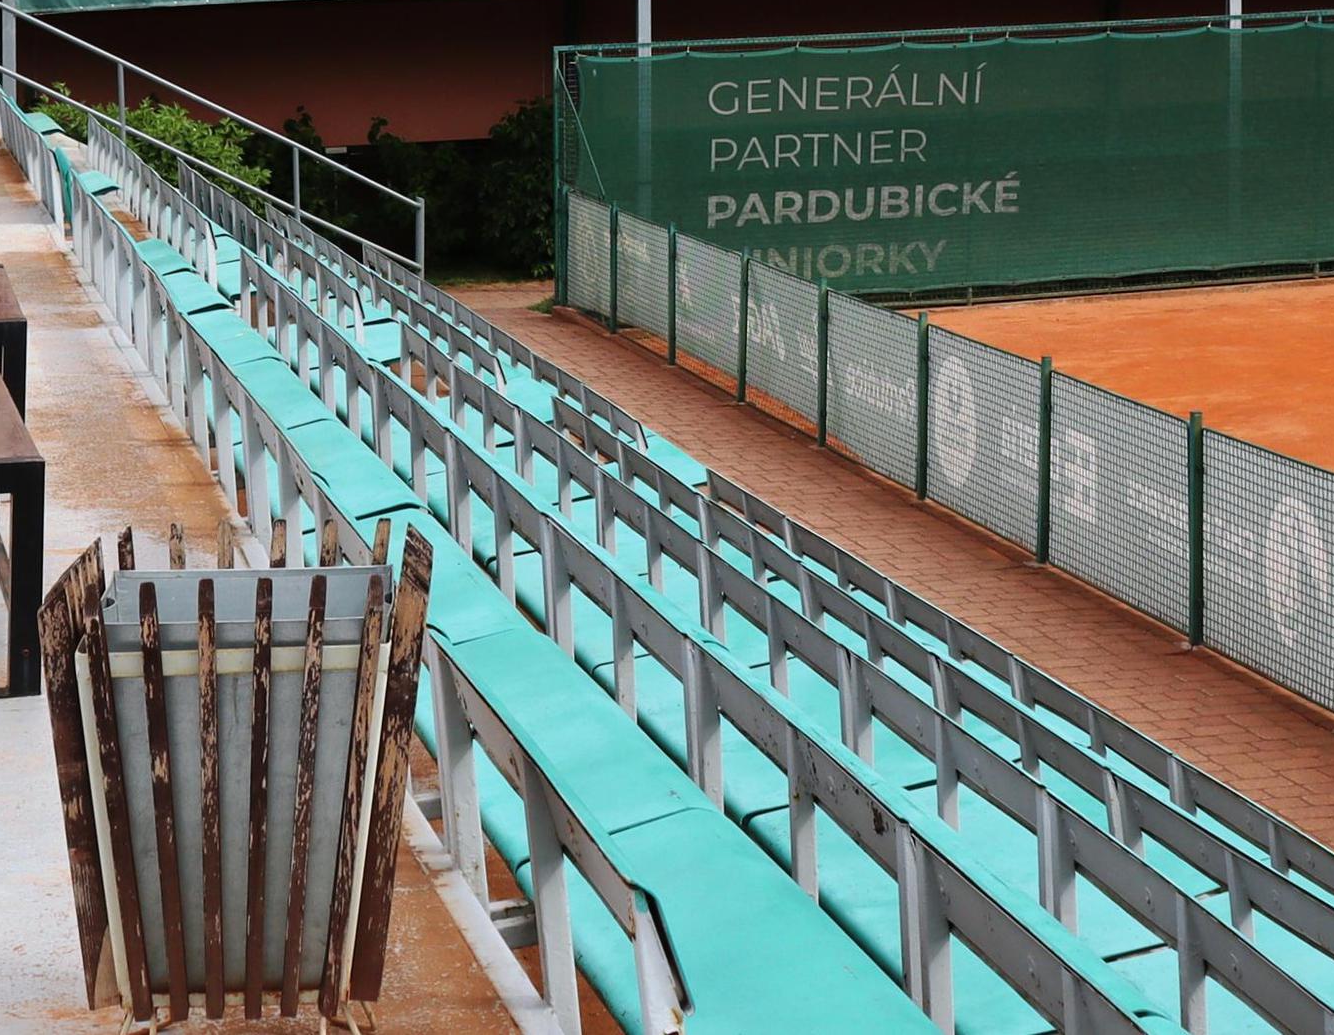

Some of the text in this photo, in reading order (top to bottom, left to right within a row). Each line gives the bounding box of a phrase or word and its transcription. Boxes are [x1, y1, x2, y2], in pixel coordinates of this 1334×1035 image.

[707, 63, 985, 116] GENERÁLNÍ
[709, 128, 928, 173] PARTNER
[706, 170, 1021, 230] PARDUBICKÉ
[753, 239, 948, 279] NIORKY
